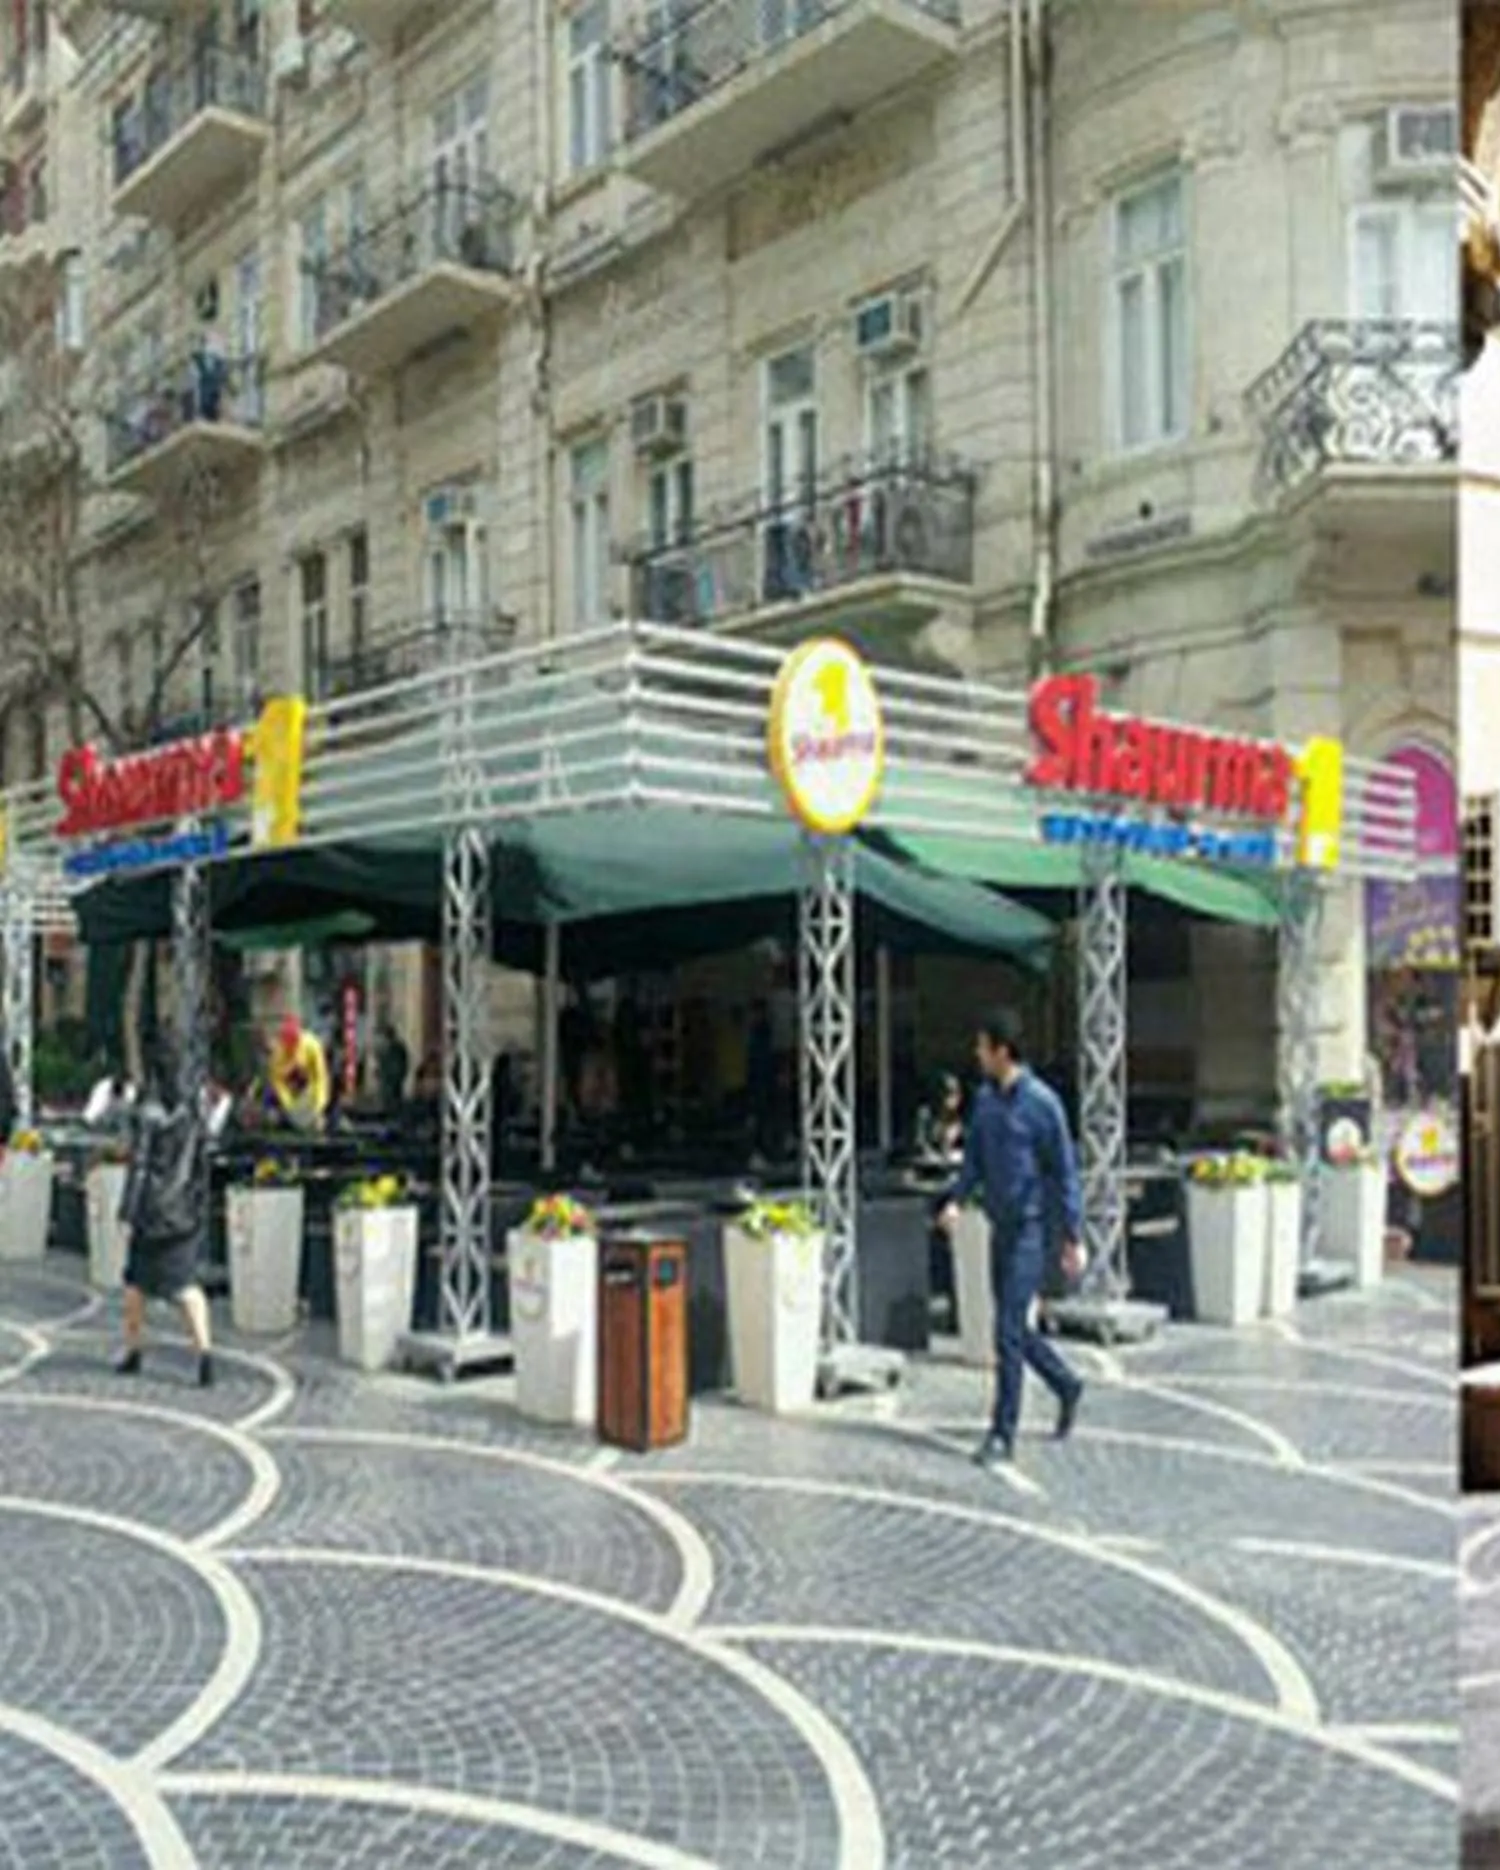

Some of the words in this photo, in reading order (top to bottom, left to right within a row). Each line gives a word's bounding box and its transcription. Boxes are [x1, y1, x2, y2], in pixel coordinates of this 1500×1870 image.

[56, 725, 246, 836] Shaurma
[244, 697, 305, 847] 1
[1024, 674, 1290, 822] Shaurma
[1291, 735, 1342, 872] 1
